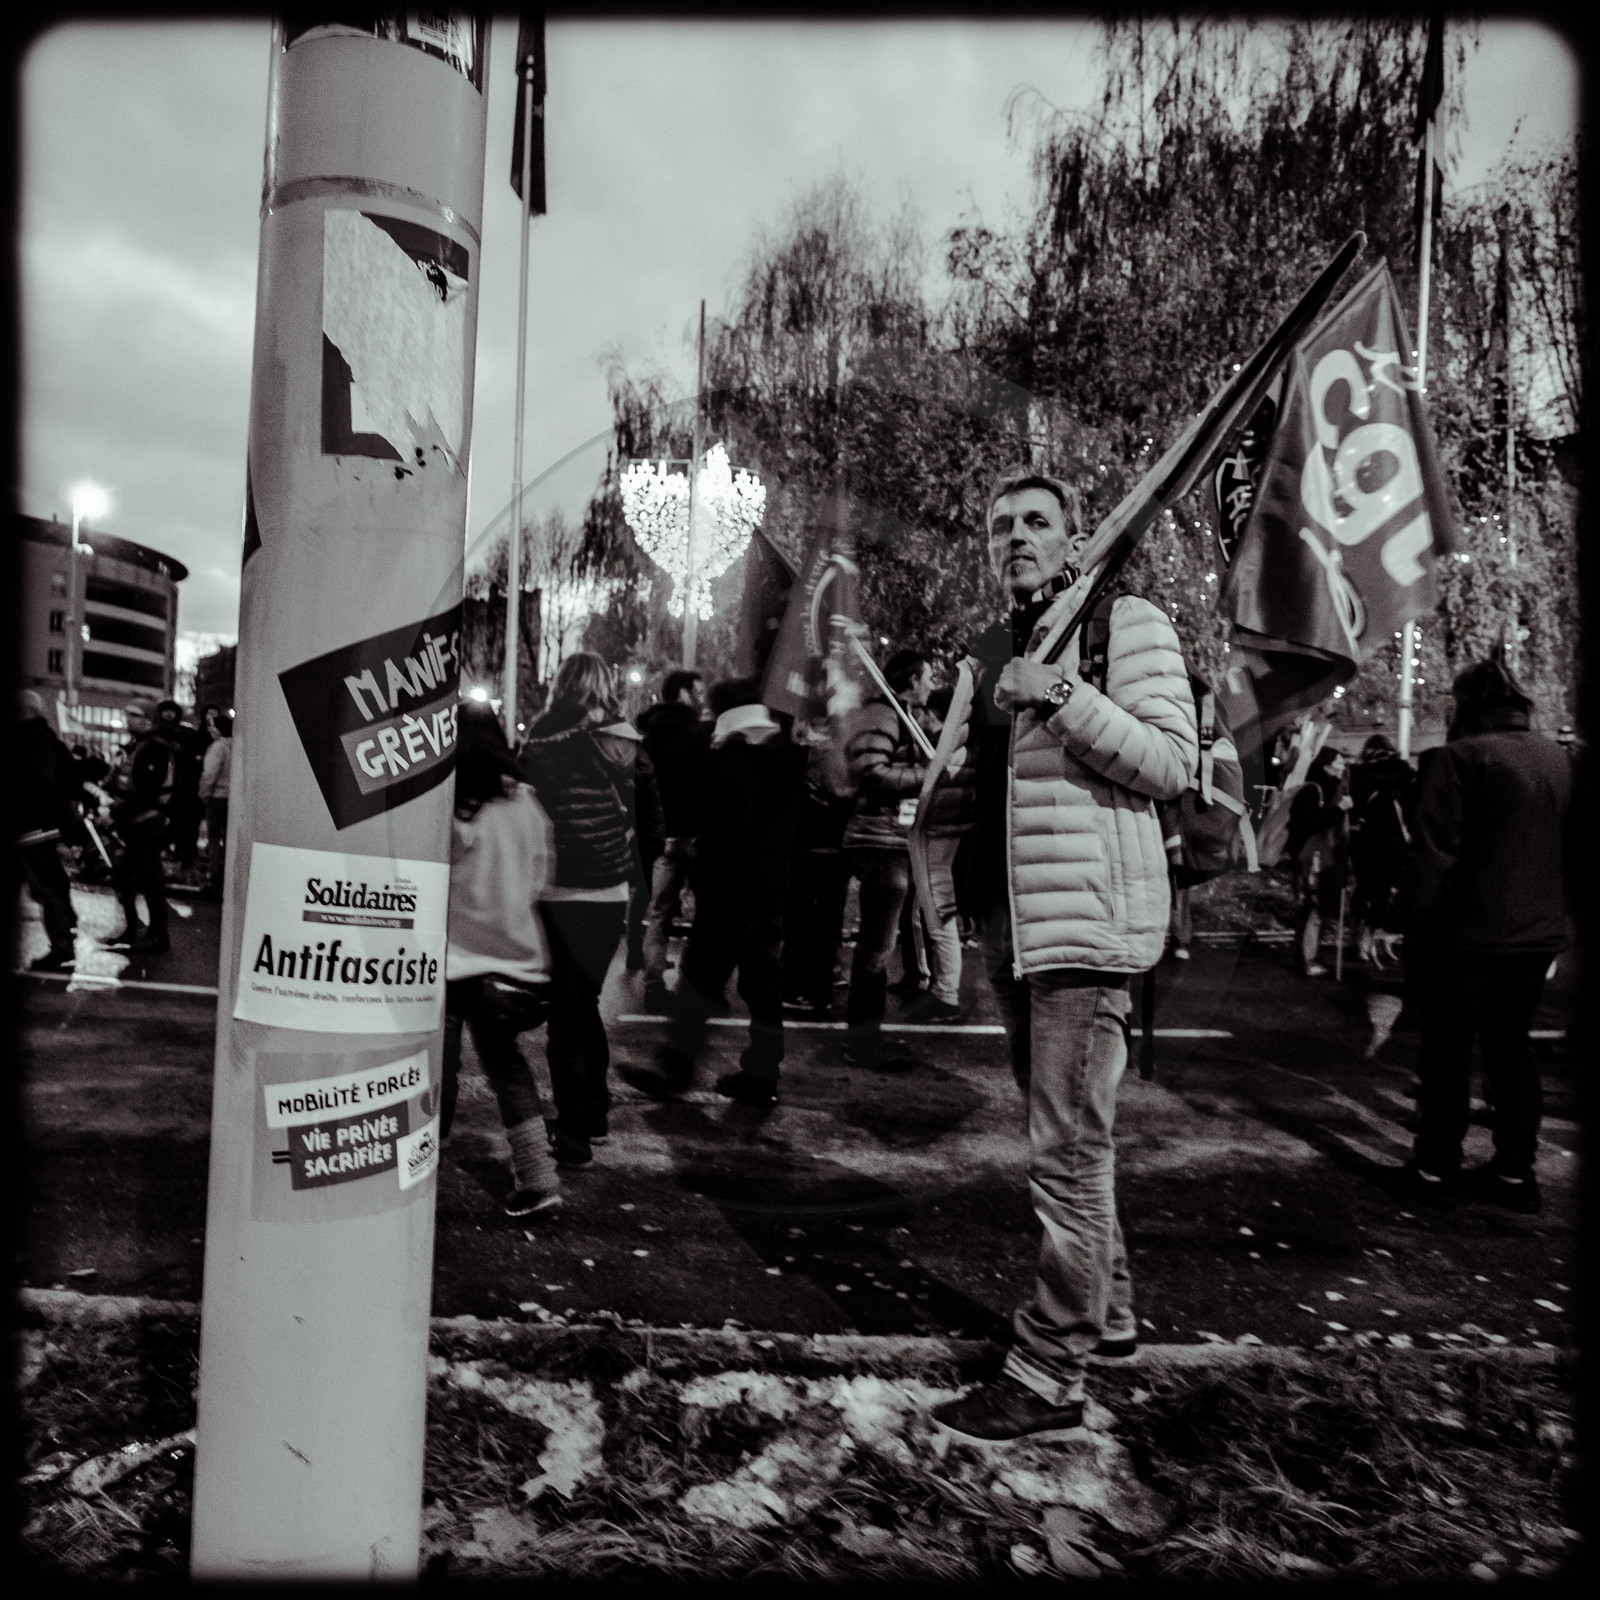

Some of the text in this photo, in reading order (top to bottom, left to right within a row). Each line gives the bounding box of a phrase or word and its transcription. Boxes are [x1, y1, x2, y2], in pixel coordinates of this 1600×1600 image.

[355, 703, 458, 778] GRÈVES
[305, 877, 417, 912] Solidaires
[253, 932, 438, 986] Antifasciste
